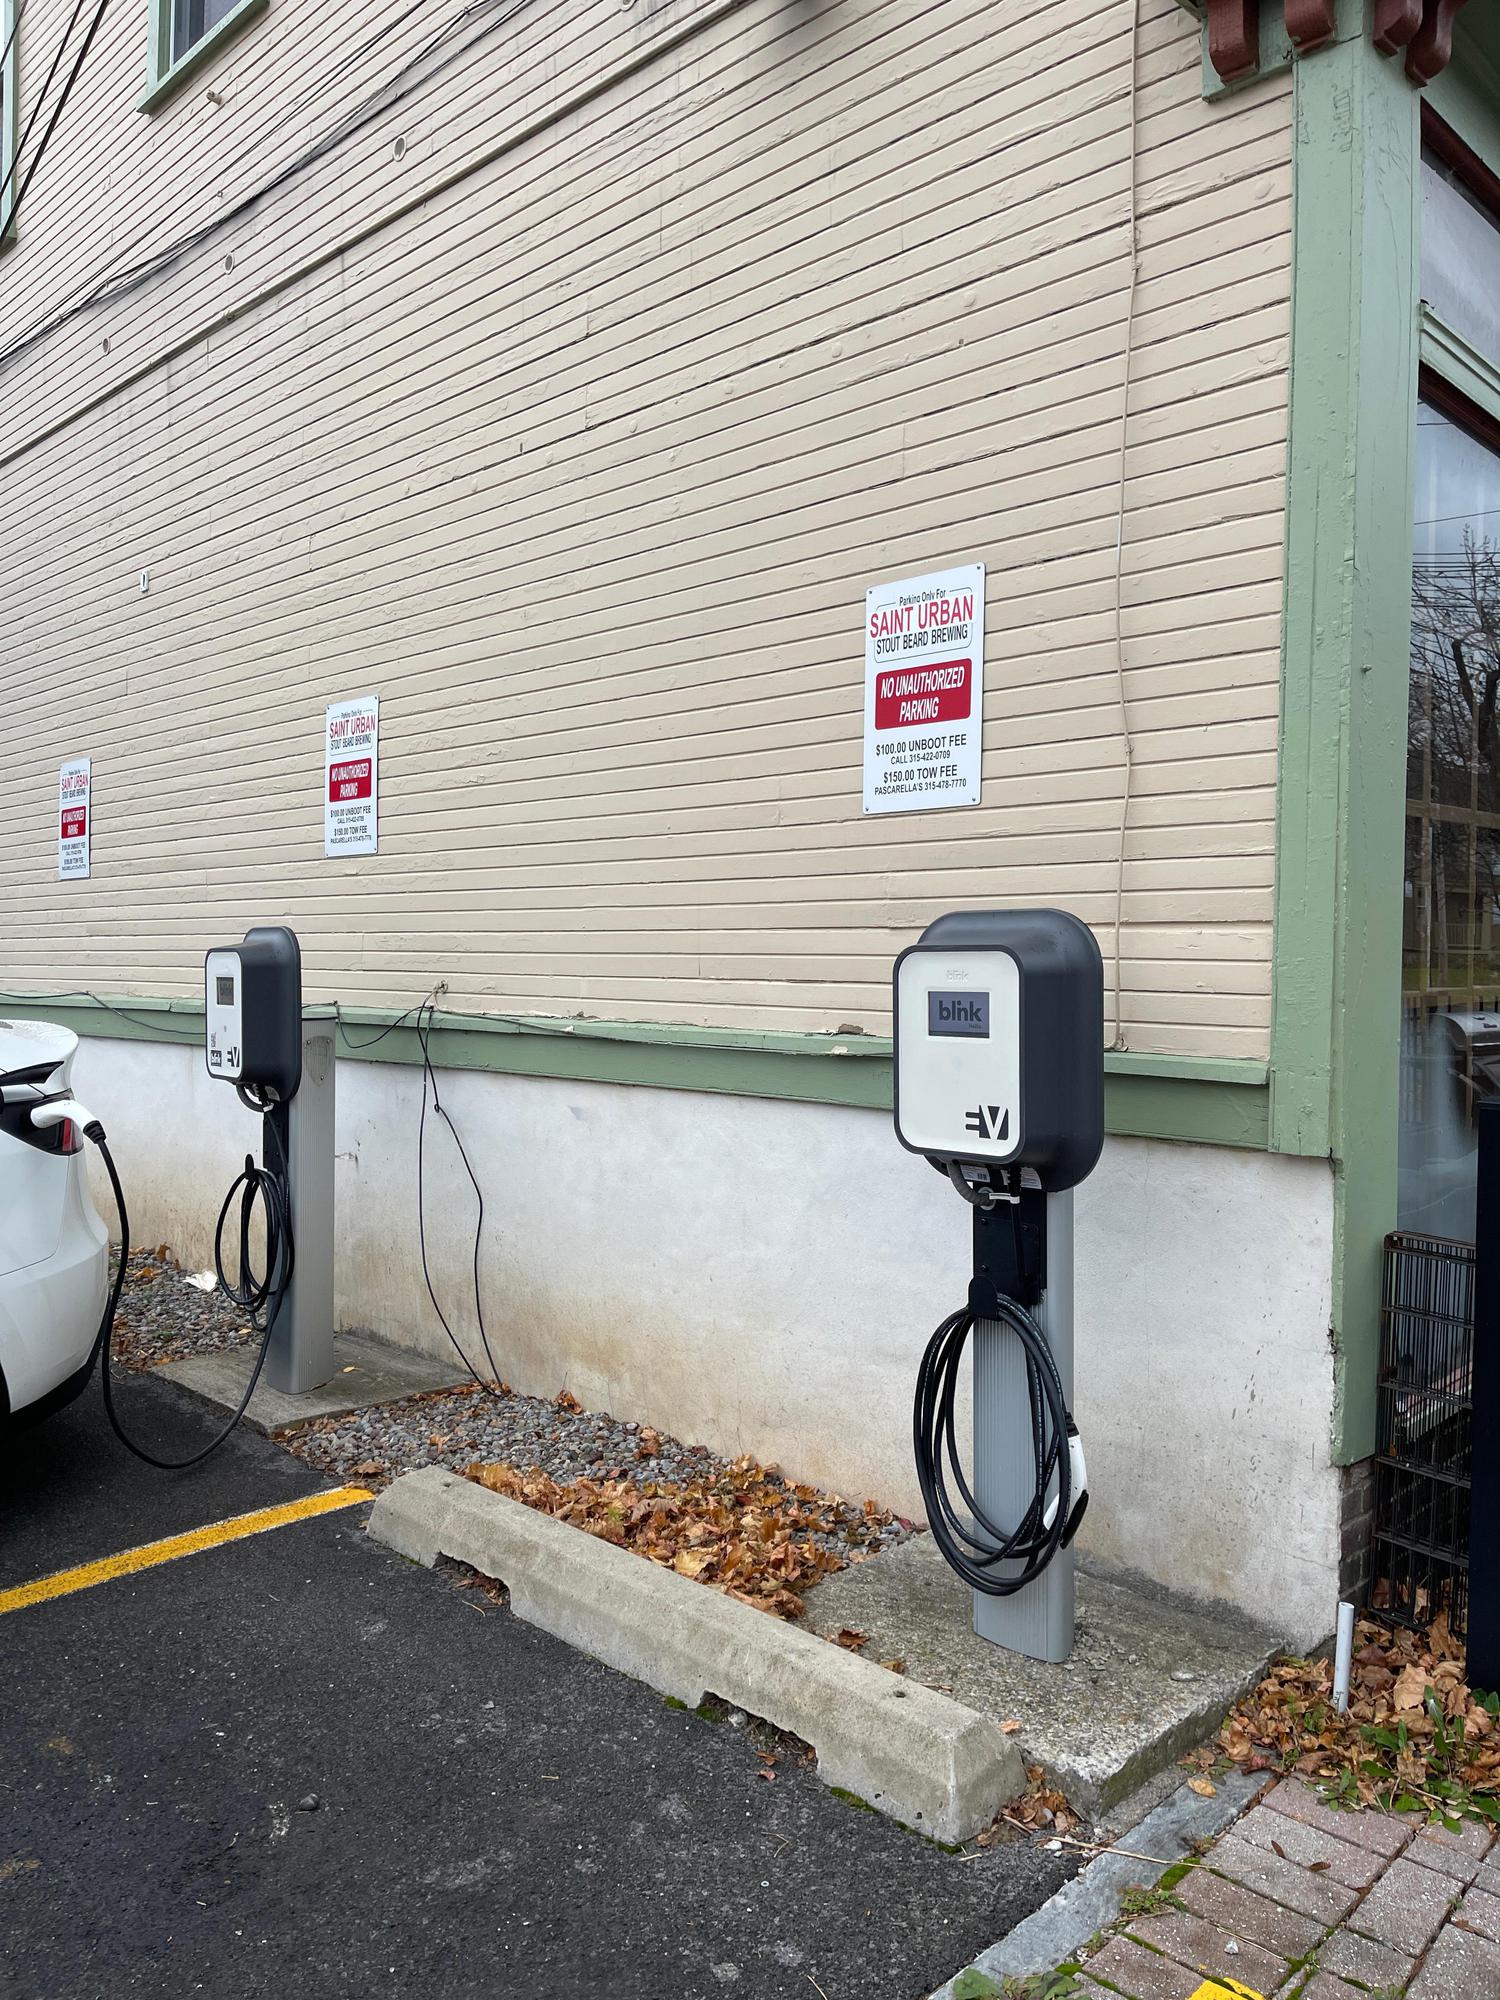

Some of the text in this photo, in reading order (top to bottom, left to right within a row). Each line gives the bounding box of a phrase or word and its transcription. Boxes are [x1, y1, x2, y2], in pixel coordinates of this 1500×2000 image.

[936, 589, 946, 599] For
[870, 594, 973, 638] SAINT URBAN
[876, 624, 968, 654] STOUT BEARD BREWING
[880, 666, 965, 699] NO UNAUTHORIZED
[899, 697, 940, 722] PARKING
[330, 719, 350, 739] SAINT
[351, 714, 376, 735] URBAN
[876, 734, 967, 756] $100.00 UNBOOT FEE
[891, 750, 951, 765] CALL 315-422-0709
[883, 764, 958, 784] $150.00 TOW FEE
[874, 783, 923, 795] PASCARELLA'S
[938, 1000, 983, 1022] blink
